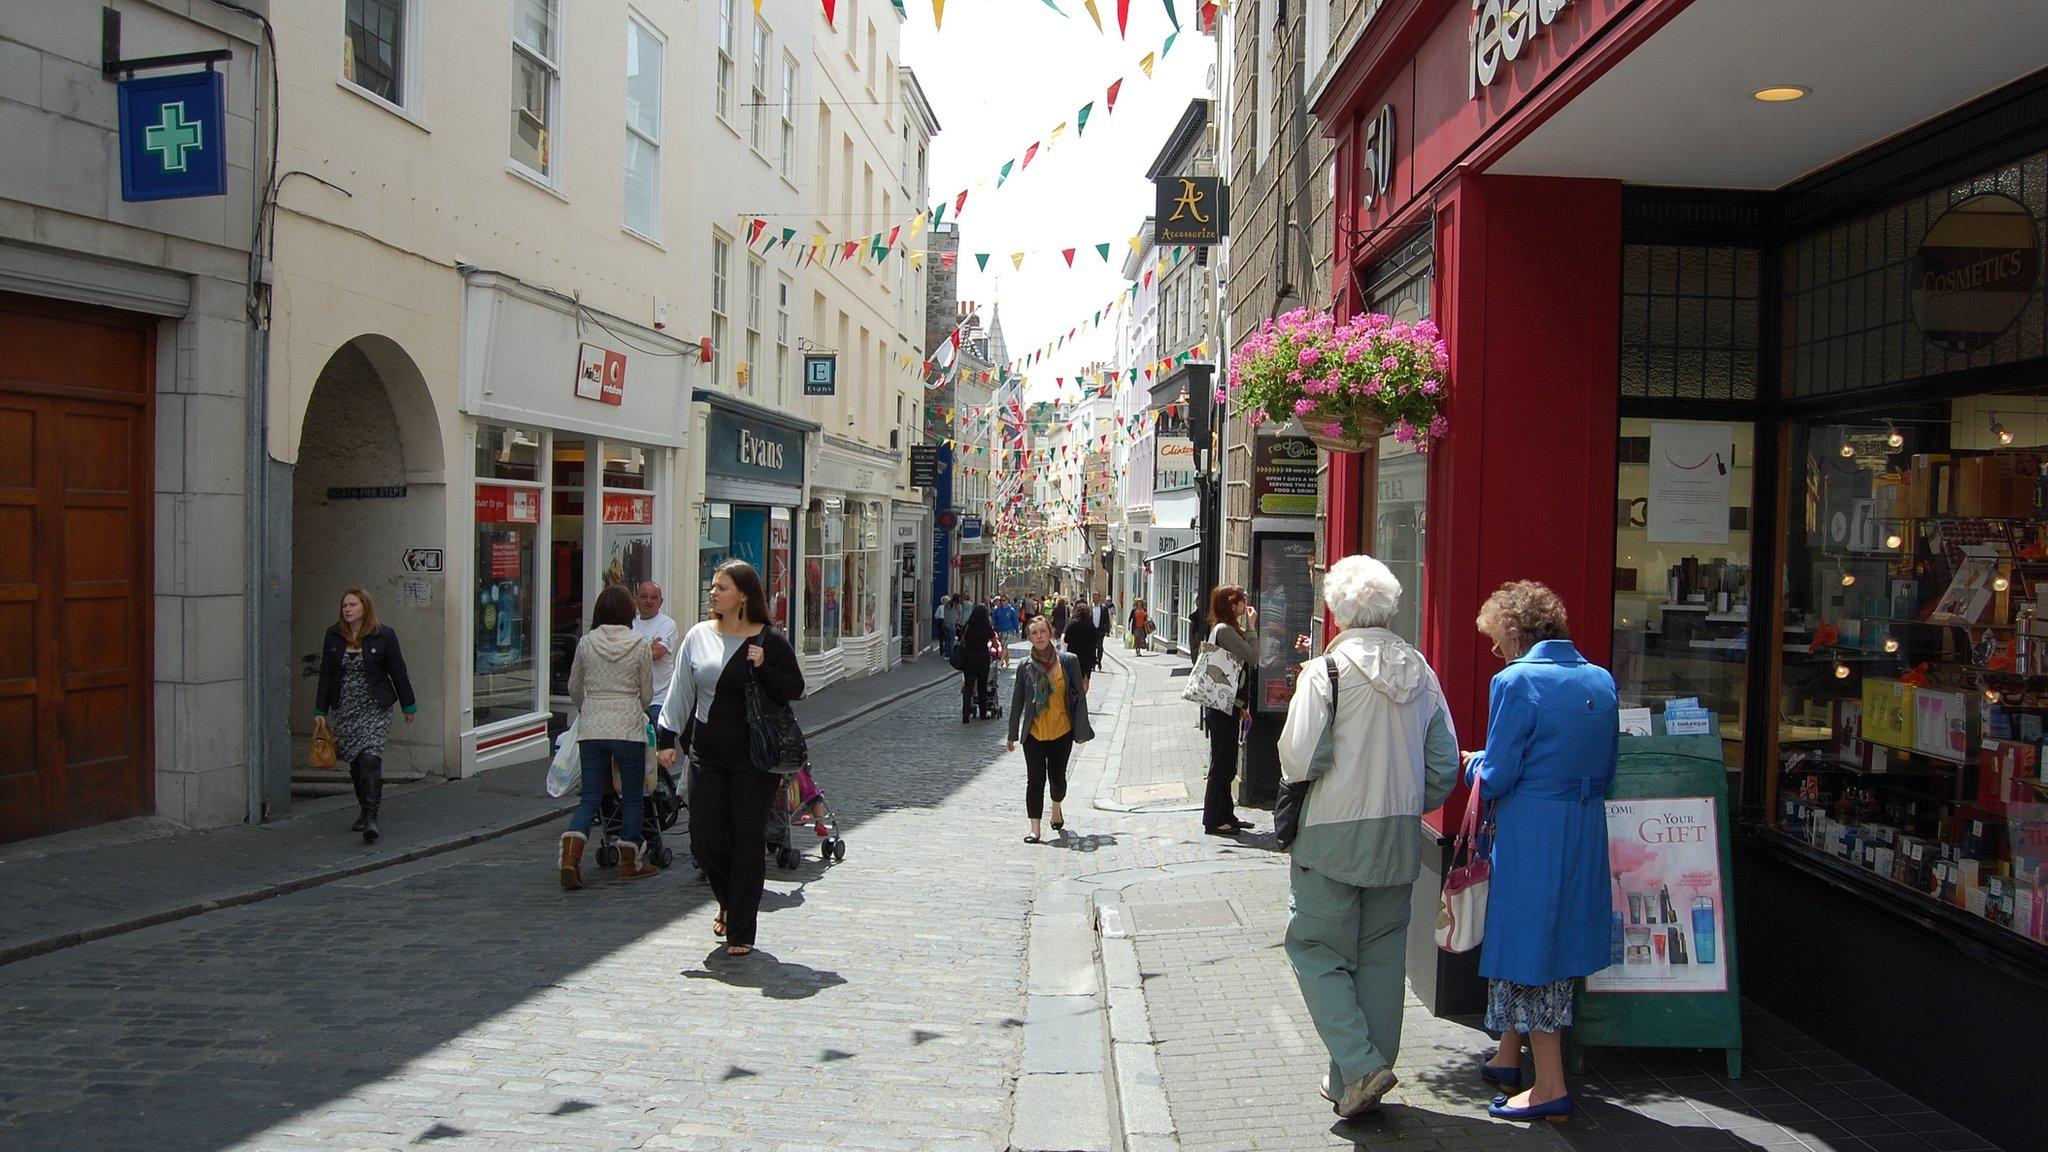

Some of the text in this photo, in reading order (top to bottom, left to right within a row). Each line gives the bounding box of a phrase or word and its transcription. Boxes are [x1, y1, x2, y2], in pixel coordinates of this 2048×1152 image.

[1364, 104, 1395, 212] 50
[1169, 179, 1209, 222] A
[1162, 227, 1216, 240] Accessorize
[739, 428, 784, 471] Evans
[380, 487, 404, 497] STEPS
[1639, 818, 1707, 844] GIFT
[1663, 813, 1694, 824] YOUR
